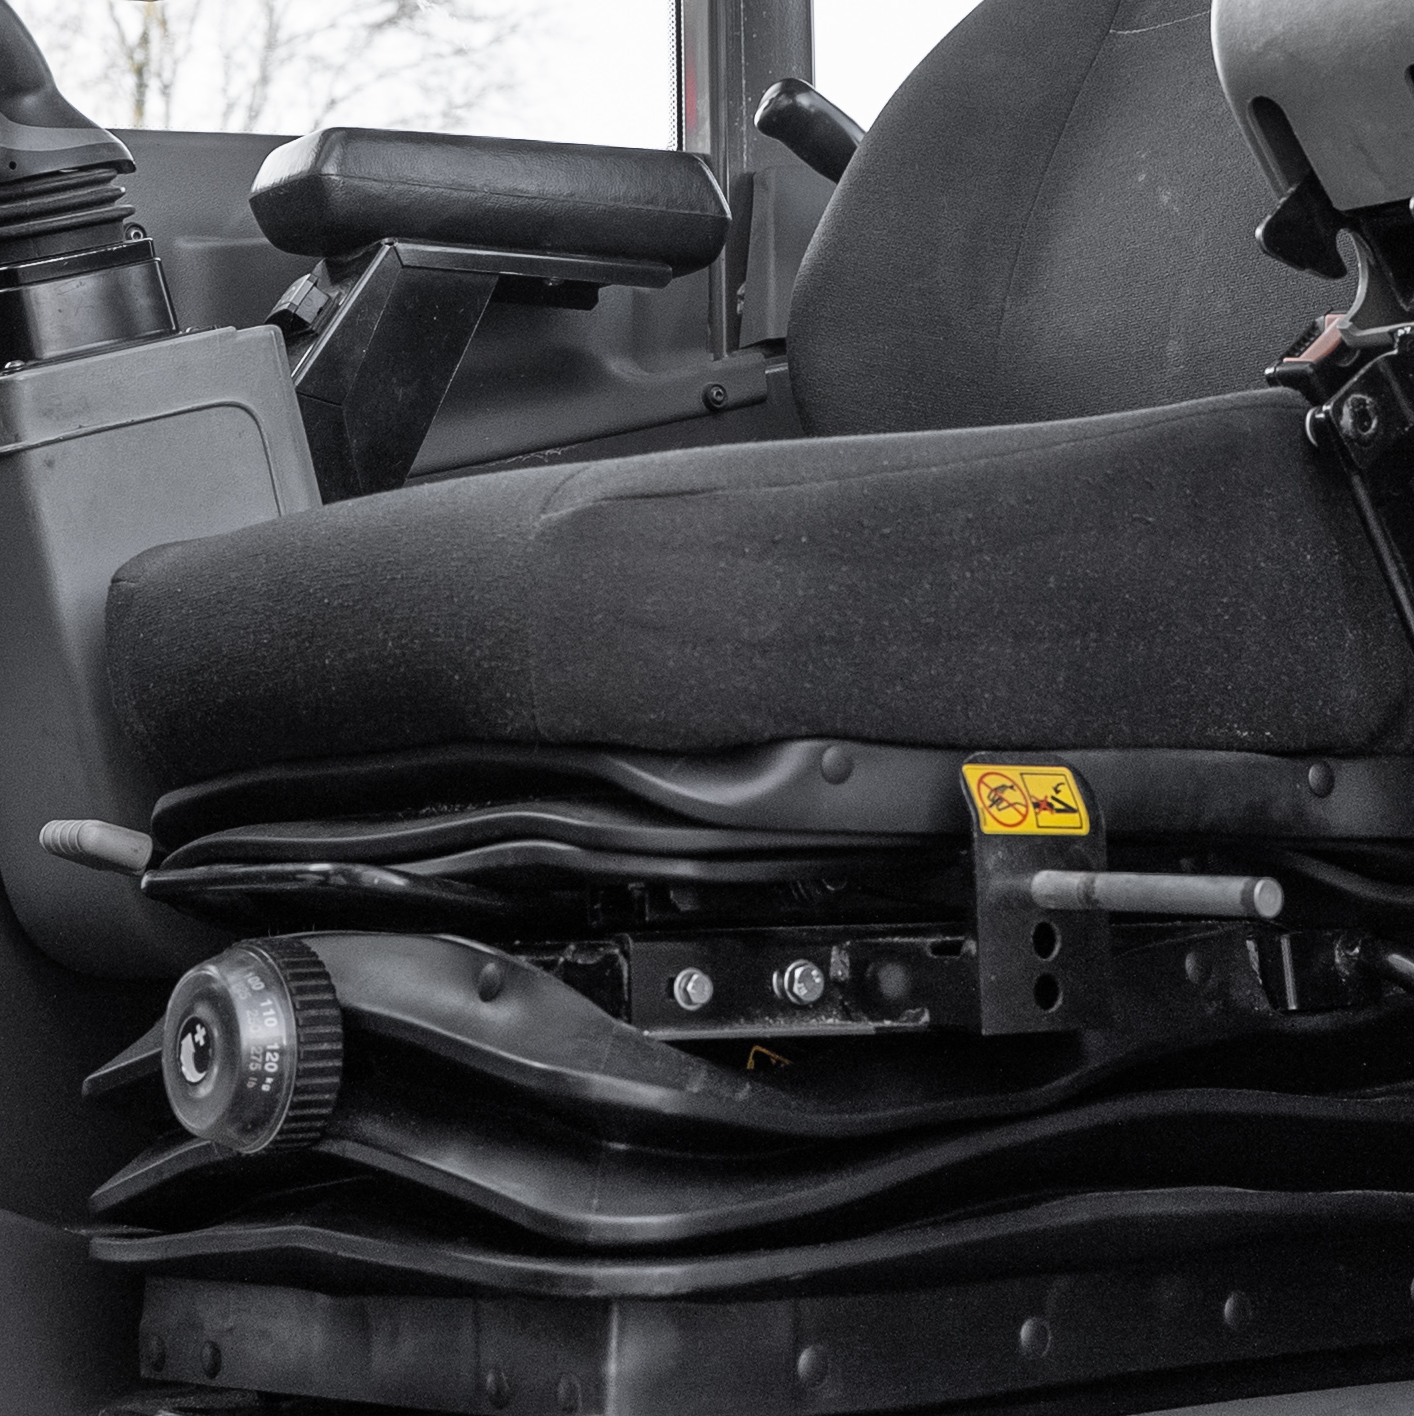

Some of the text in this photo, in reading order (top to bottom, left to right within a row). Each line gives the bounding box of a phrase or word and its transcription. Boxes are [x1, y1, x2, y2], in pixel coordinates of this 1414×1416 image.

[243, 971, 265, 991] 100
[260, 998, 278, 1027] 110
[249, 1046, 263, 1071] 275
[264, 1042, 280, 1073] 120
